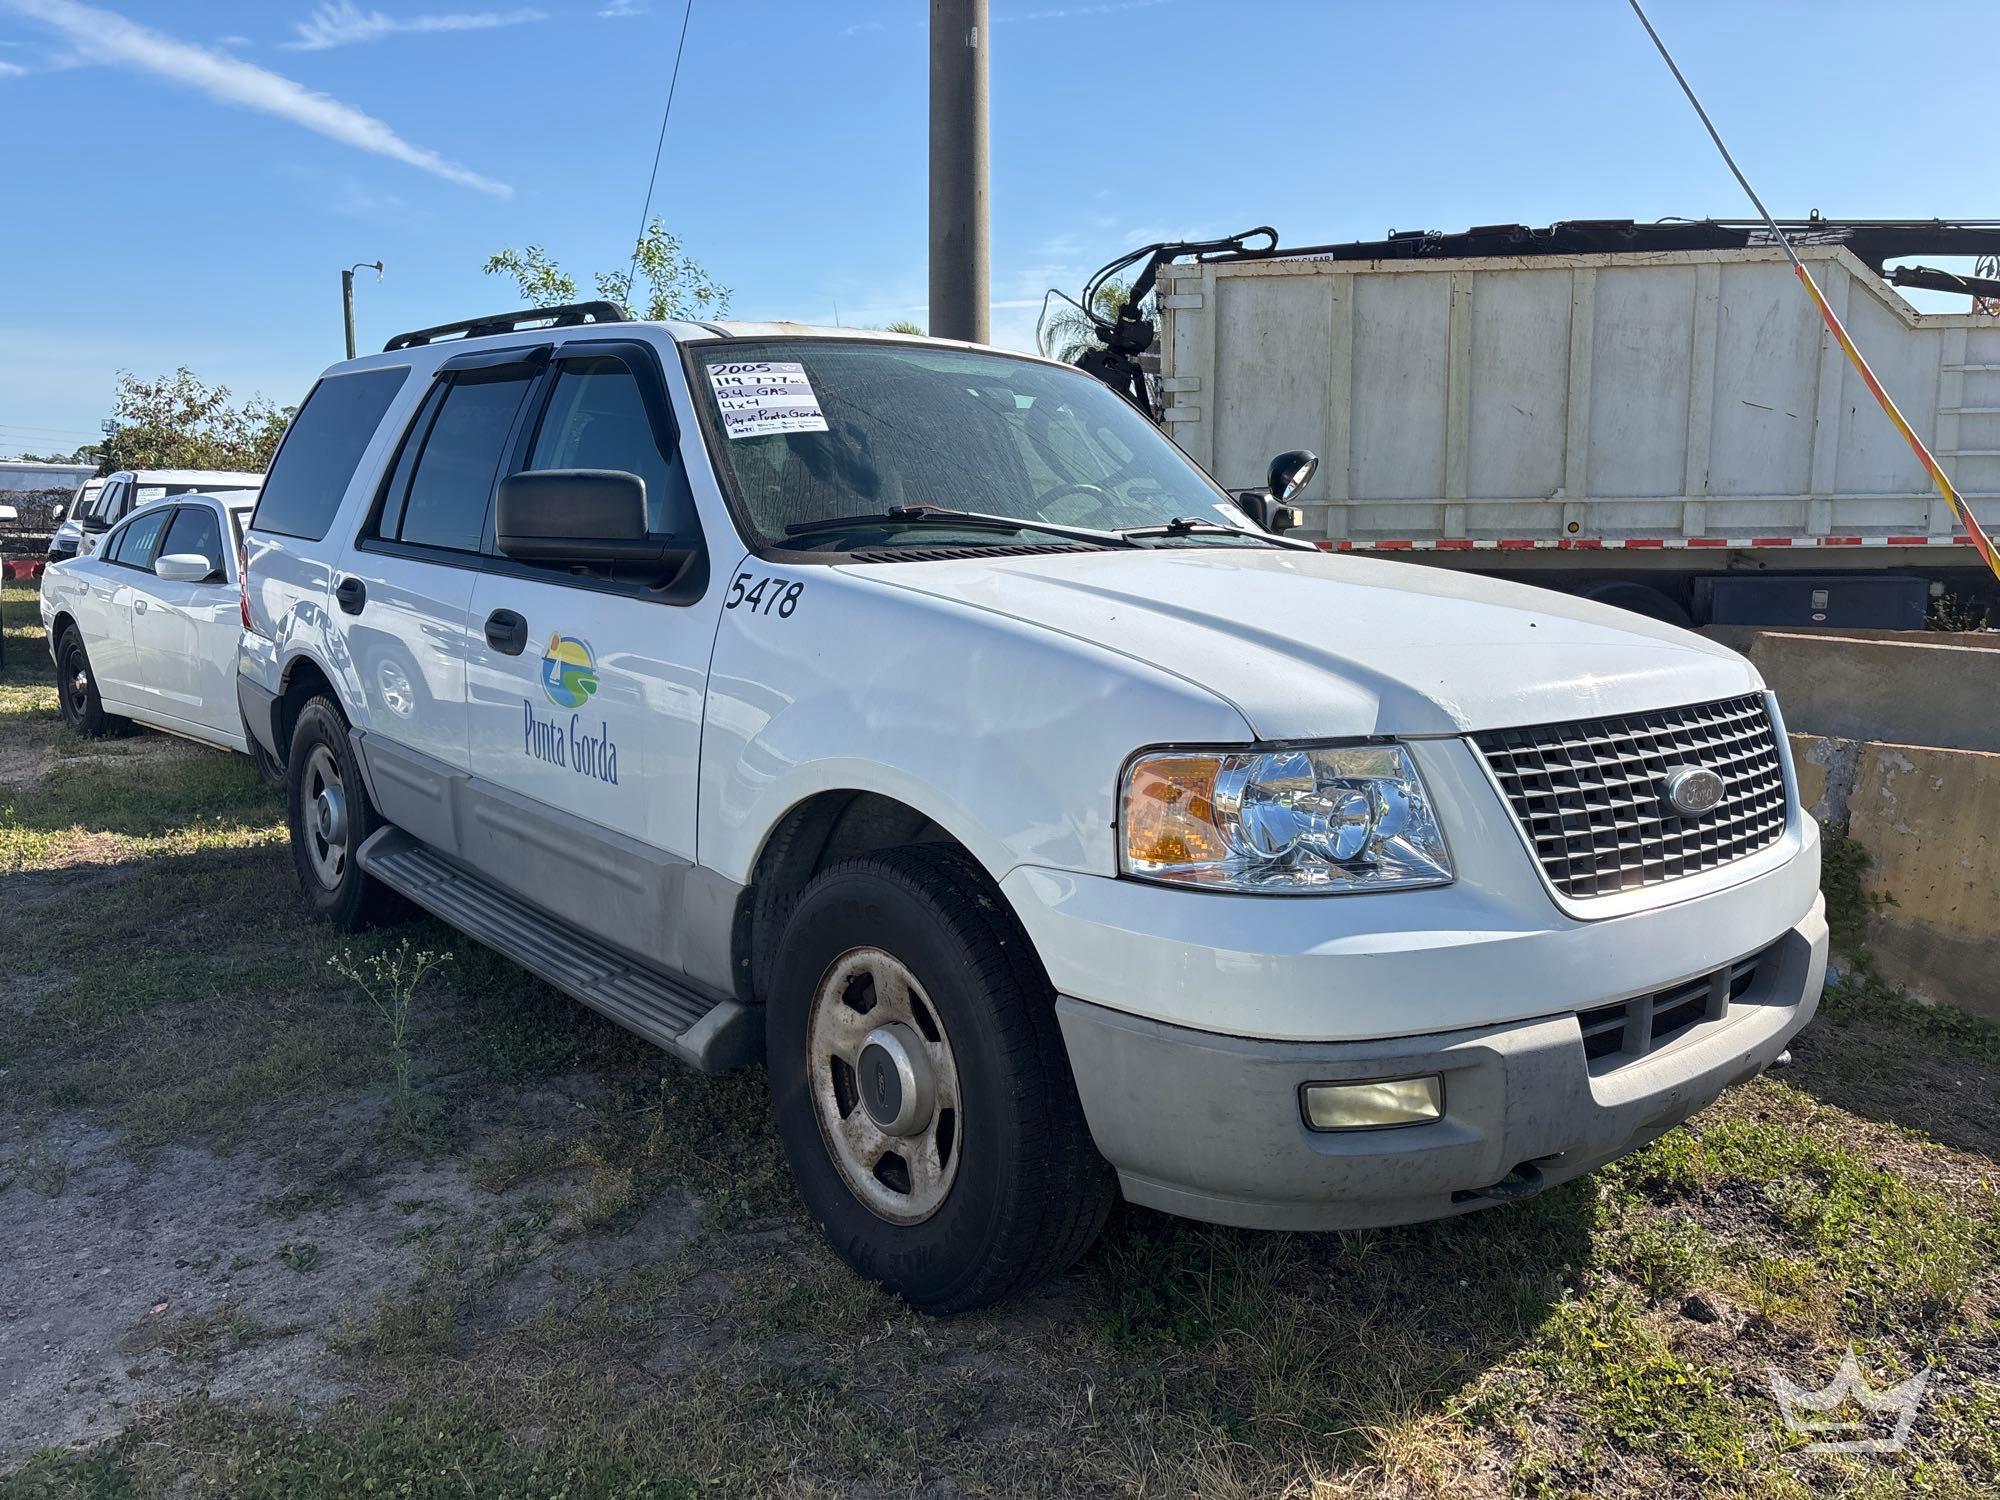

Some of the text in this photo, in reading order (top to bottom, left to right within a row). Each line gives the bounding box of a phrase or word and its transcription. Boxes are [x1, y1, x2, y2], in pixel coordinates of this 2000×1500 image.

[711, 363, 771, 376] 2005
[756, 387, 788, 396] GAS
[721, 398, 759, 410] 4x4
[724, 413, 744, 427] City
[758, 409, 788, 421] Punta
[725, 572, 805, 619] 5478
[523, 699, 619, 786] Punta Gorda
